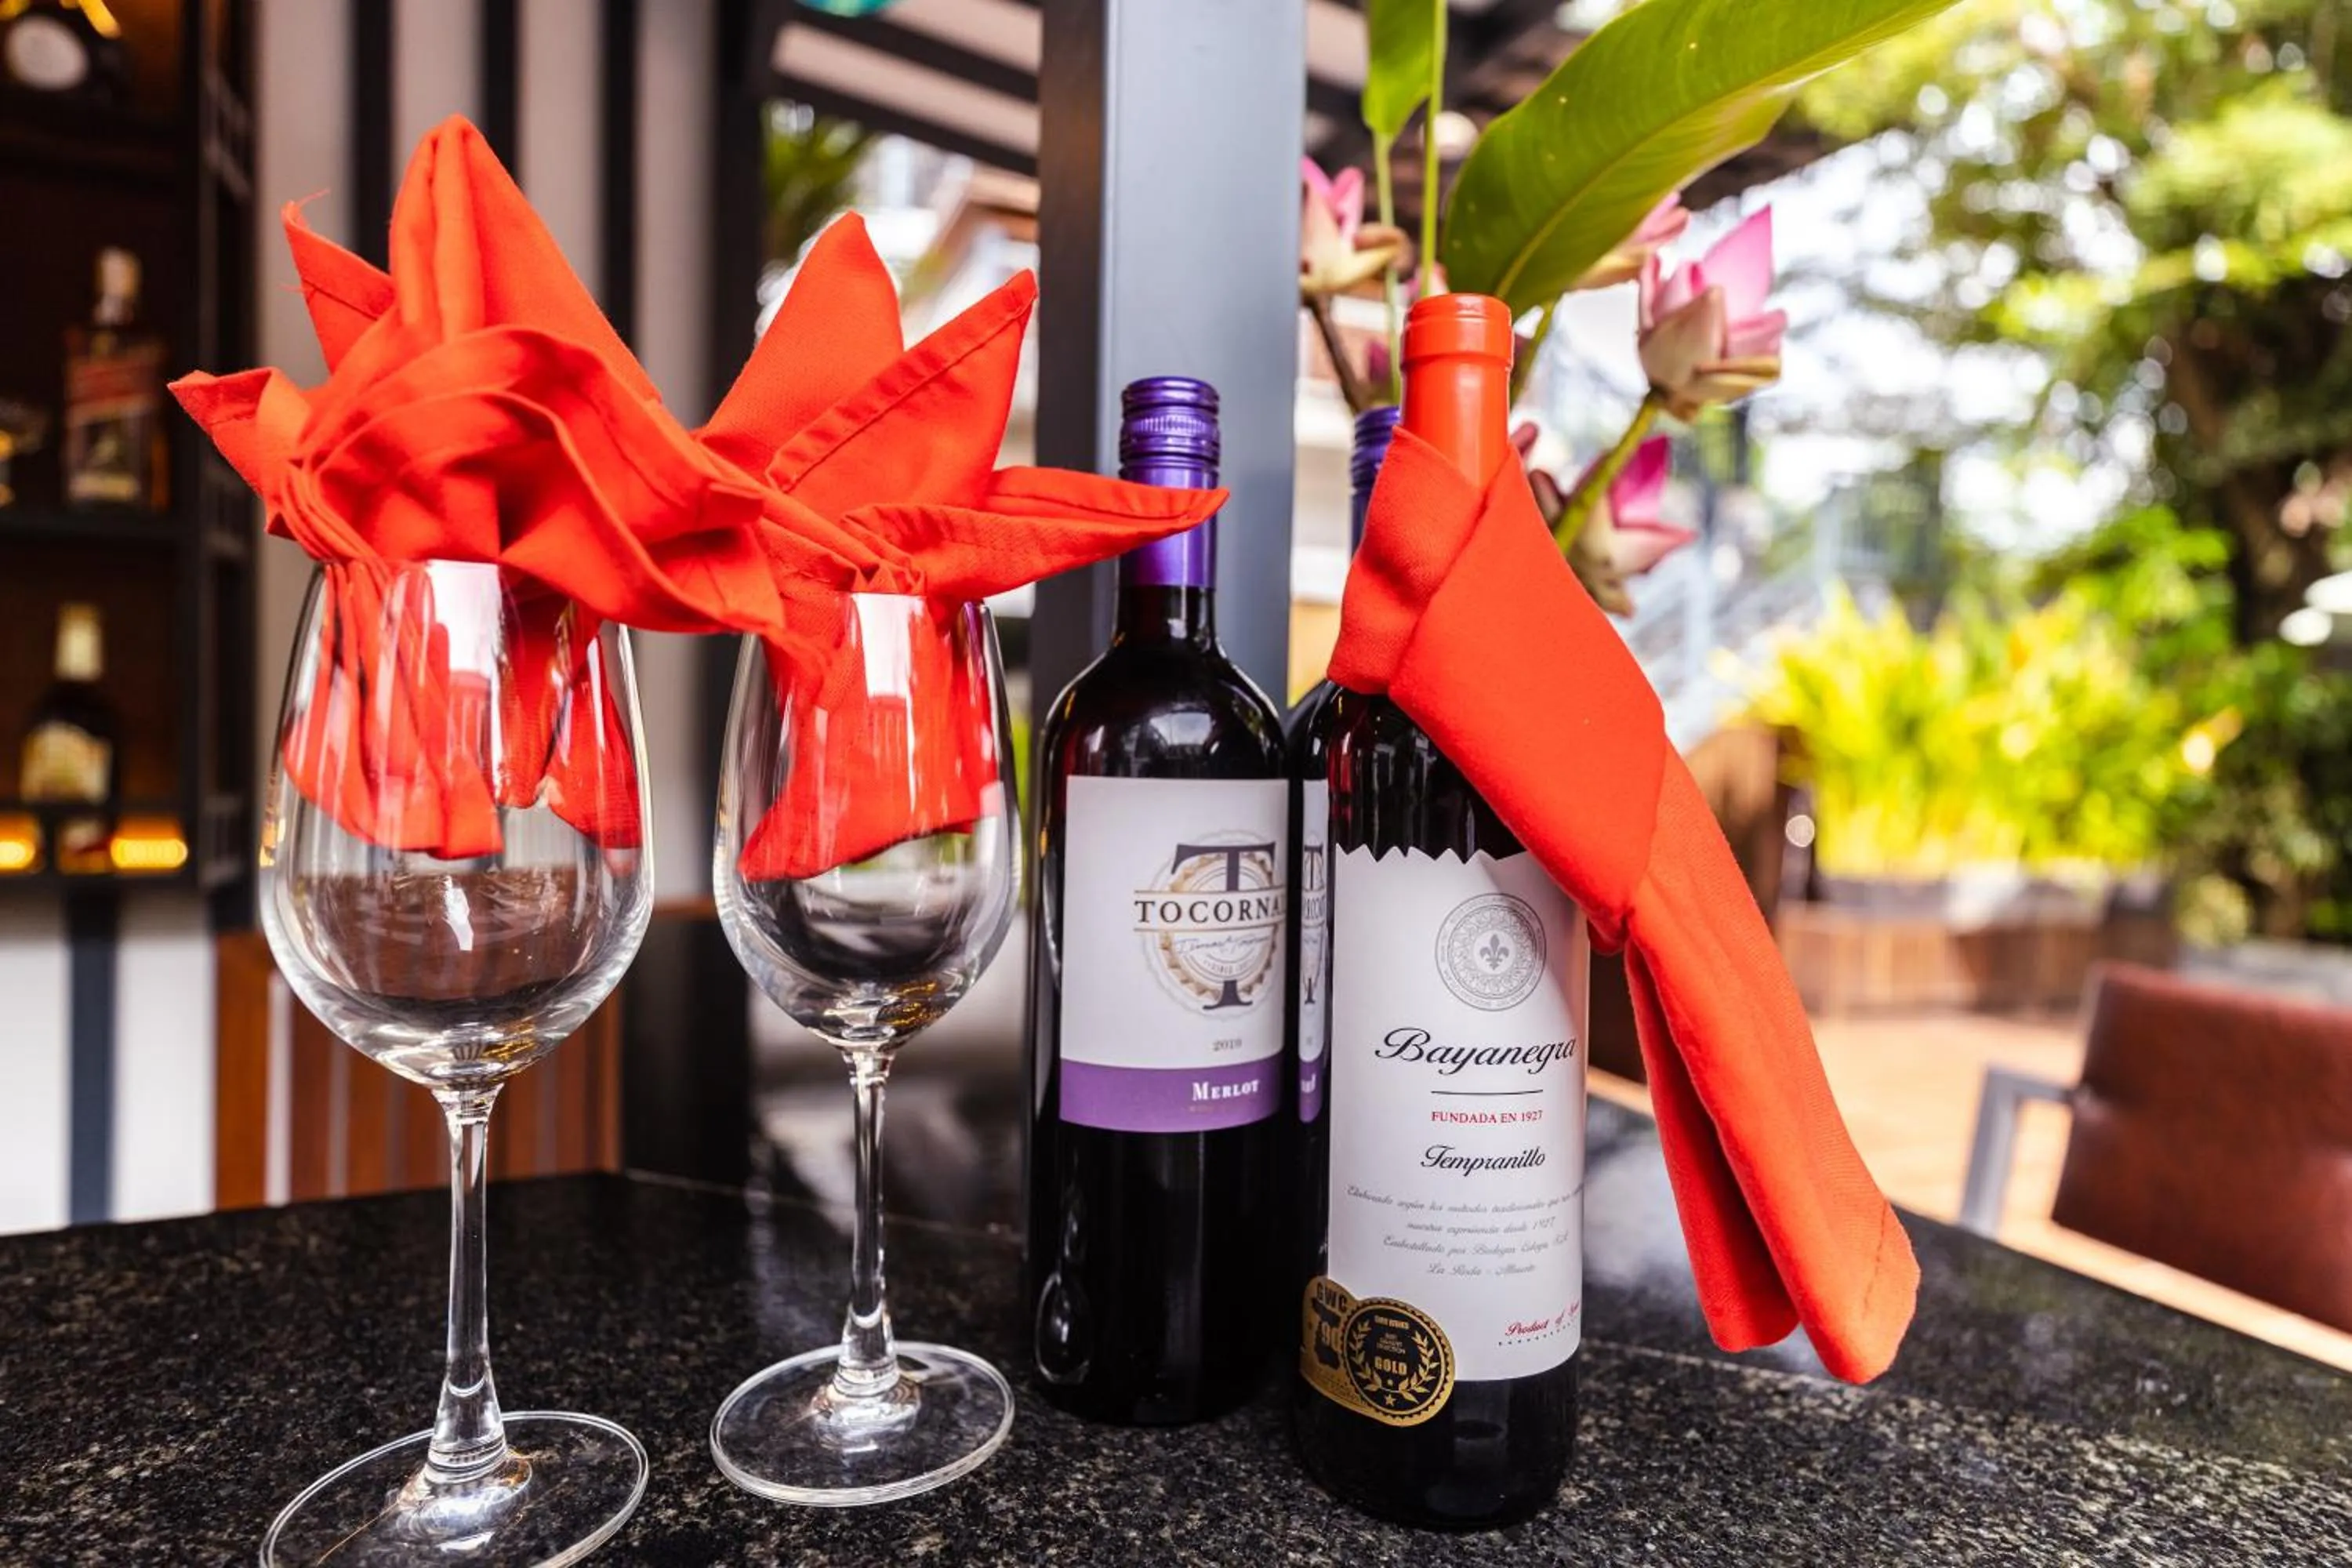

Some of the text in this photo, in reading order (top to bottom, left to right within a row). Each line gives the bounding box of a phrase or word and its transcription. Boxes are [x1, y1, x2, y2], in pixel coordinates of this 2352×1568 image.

[1134, 895, 1286, 923] TOCORNA
[1375, 1027, 1577, 1075] Bayanegra
[1432, 1109, 1544, 1123] FUNDADA EN 1927
[1421, 1144, 1546, 1177] Tempranillo
[1374, 1356, 1407, 1376] GOLD
